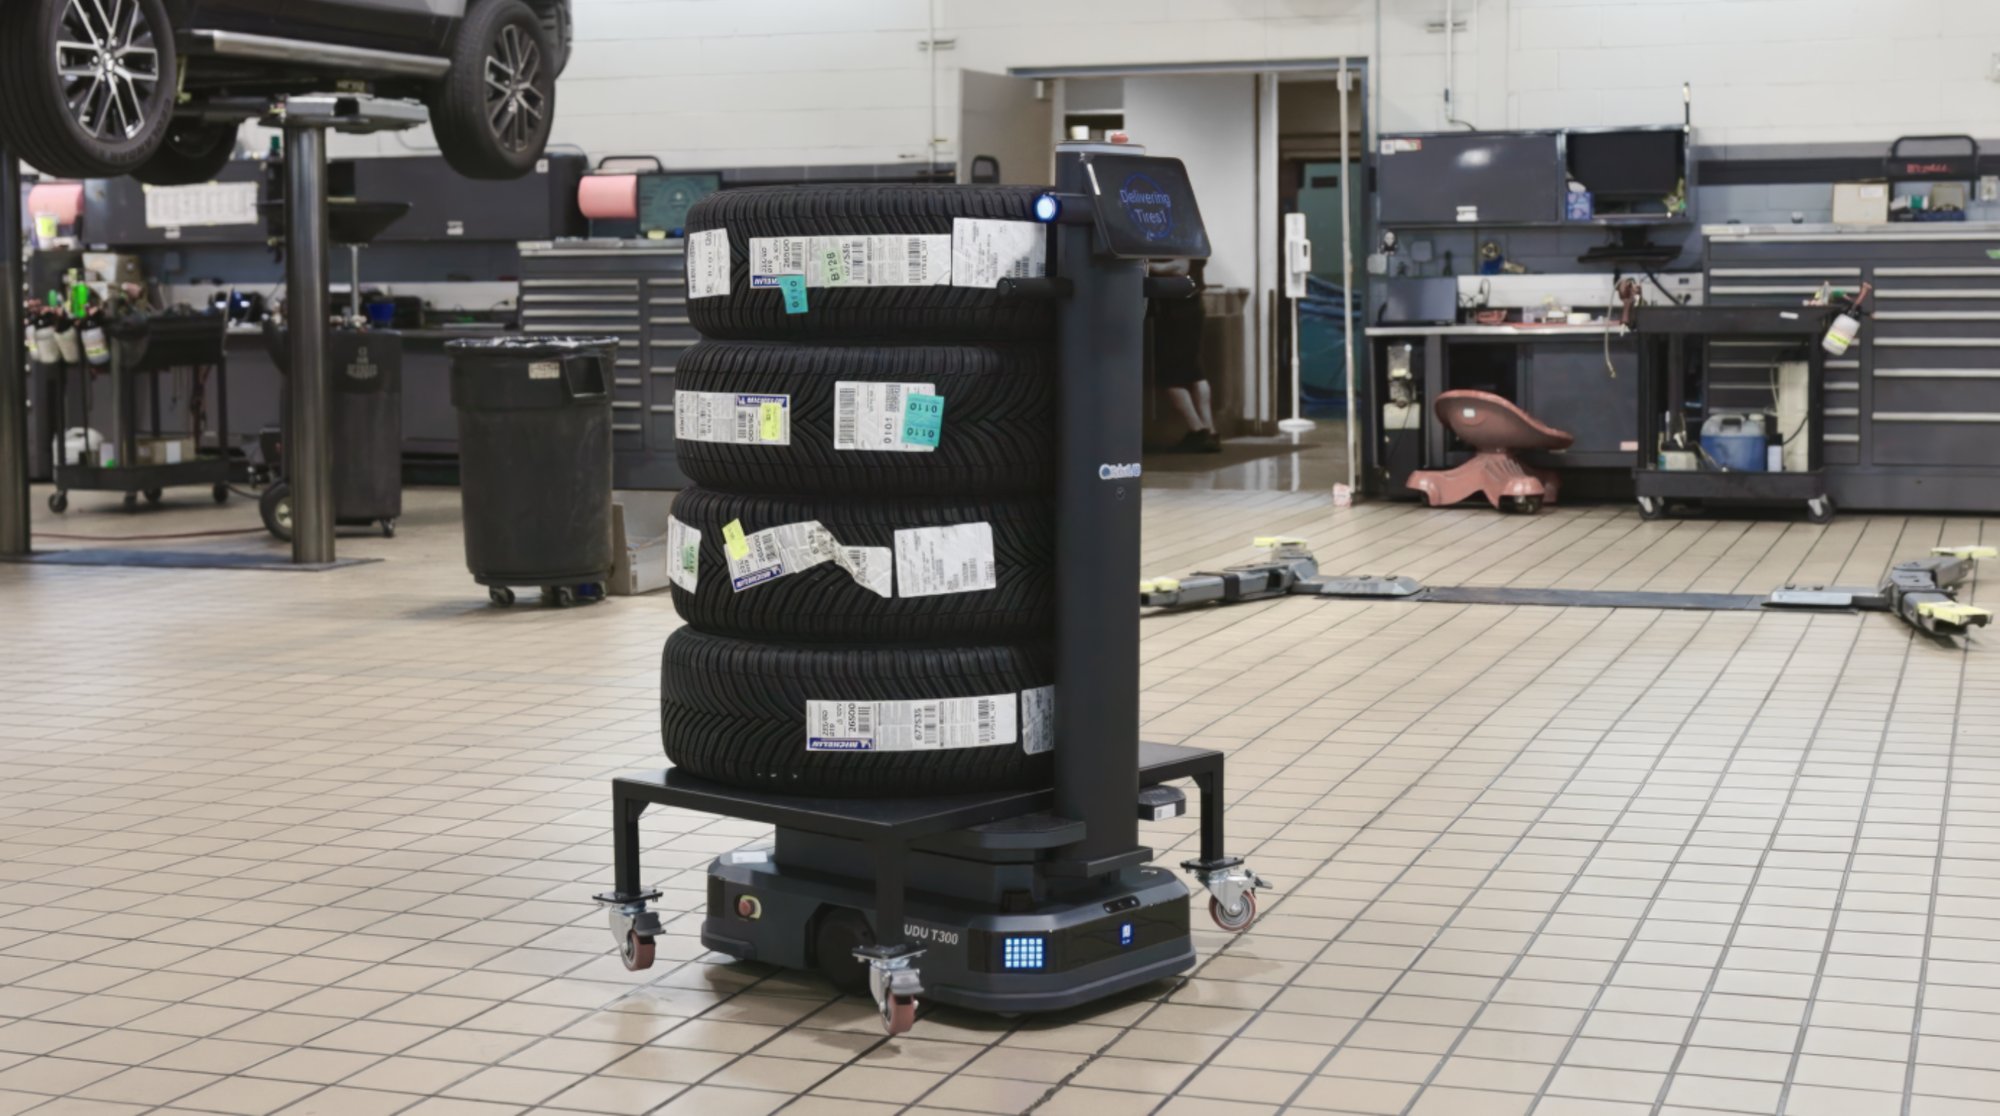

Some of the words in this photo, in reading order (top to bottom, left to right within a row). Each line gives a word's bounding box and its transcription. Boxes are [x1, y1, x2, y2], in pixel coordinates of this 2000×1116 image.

[1119, 189, 1171, 207] Delivering
[826, 252, 840, 281] B128
[909, 402, 938, 413] 0110
[906, 427, 935, 439] 0110
[848, 703, 857, 732] 26500
[904, 924, 929, 939] UDU
[931, 929, 959, 945] T300
